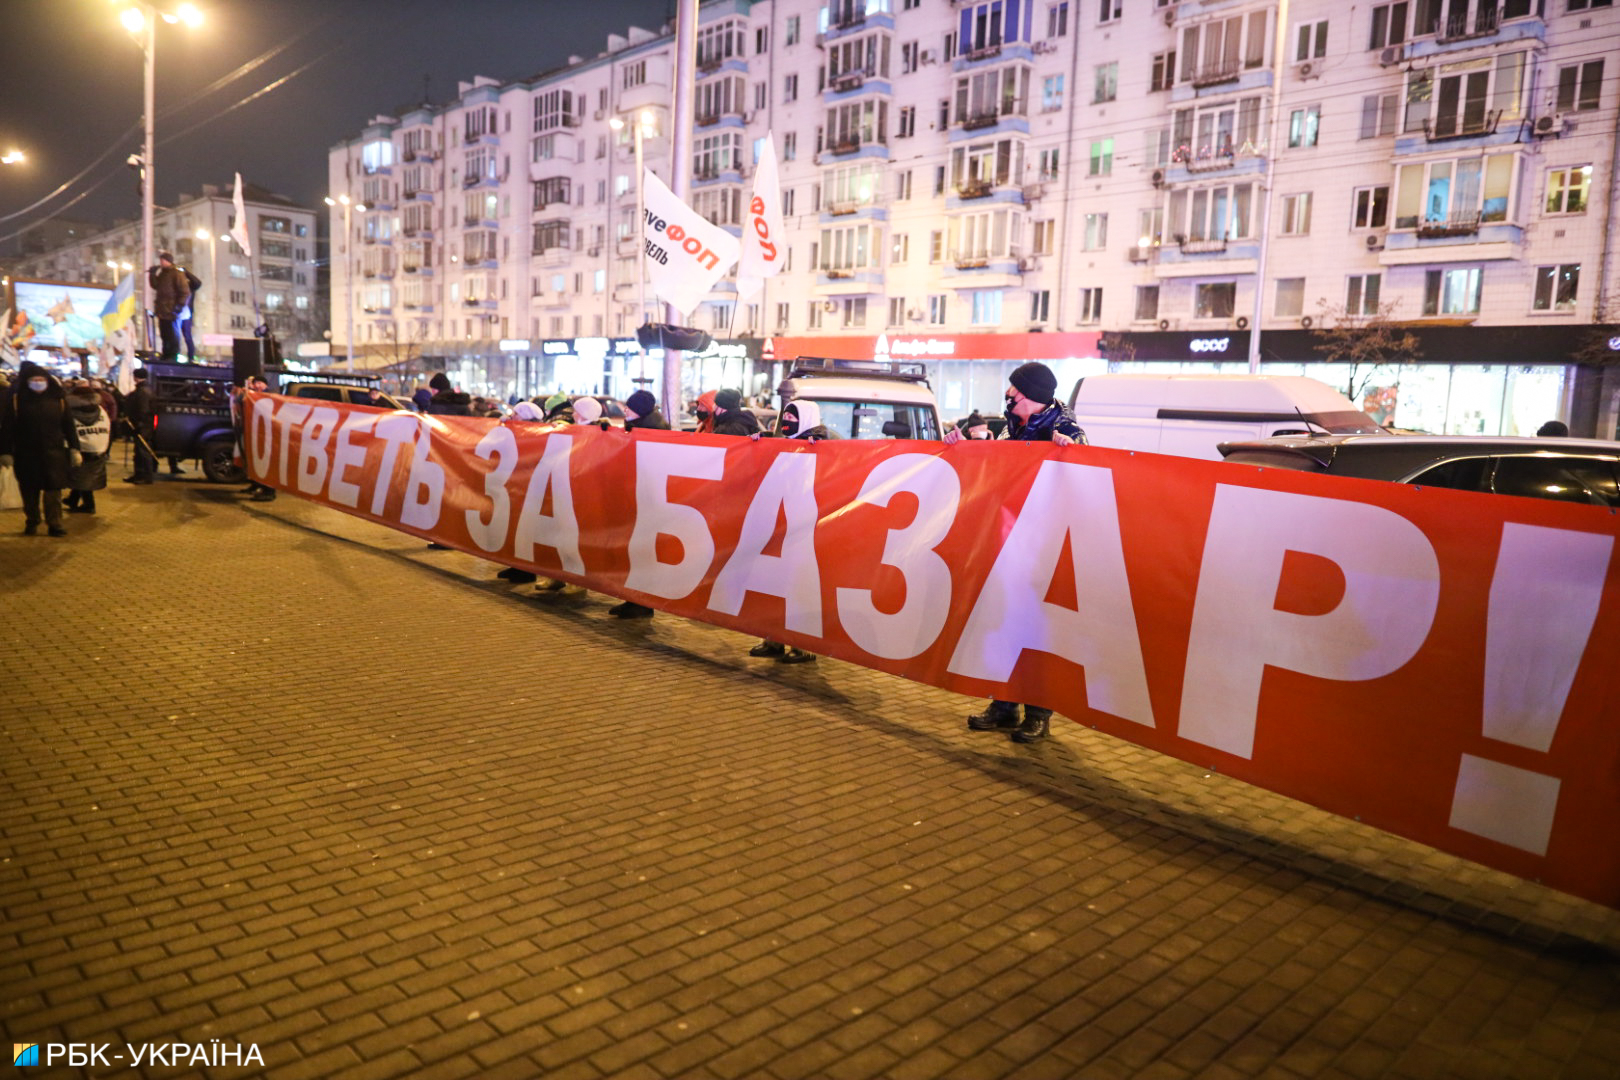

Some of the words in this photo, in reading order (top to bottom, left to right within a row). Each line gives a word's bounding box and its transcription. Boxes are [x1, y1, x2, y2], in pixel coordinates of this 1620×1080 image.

[644, 238, 668, 266] ВЕЛЬ
[750, 196, 777, 262] ФОП
[251, 398, 445, 531] ОТВЕТЬ
[465, 425, 586, 577] ЗА
[624, 440, 1615, 857] БАЗАР!
